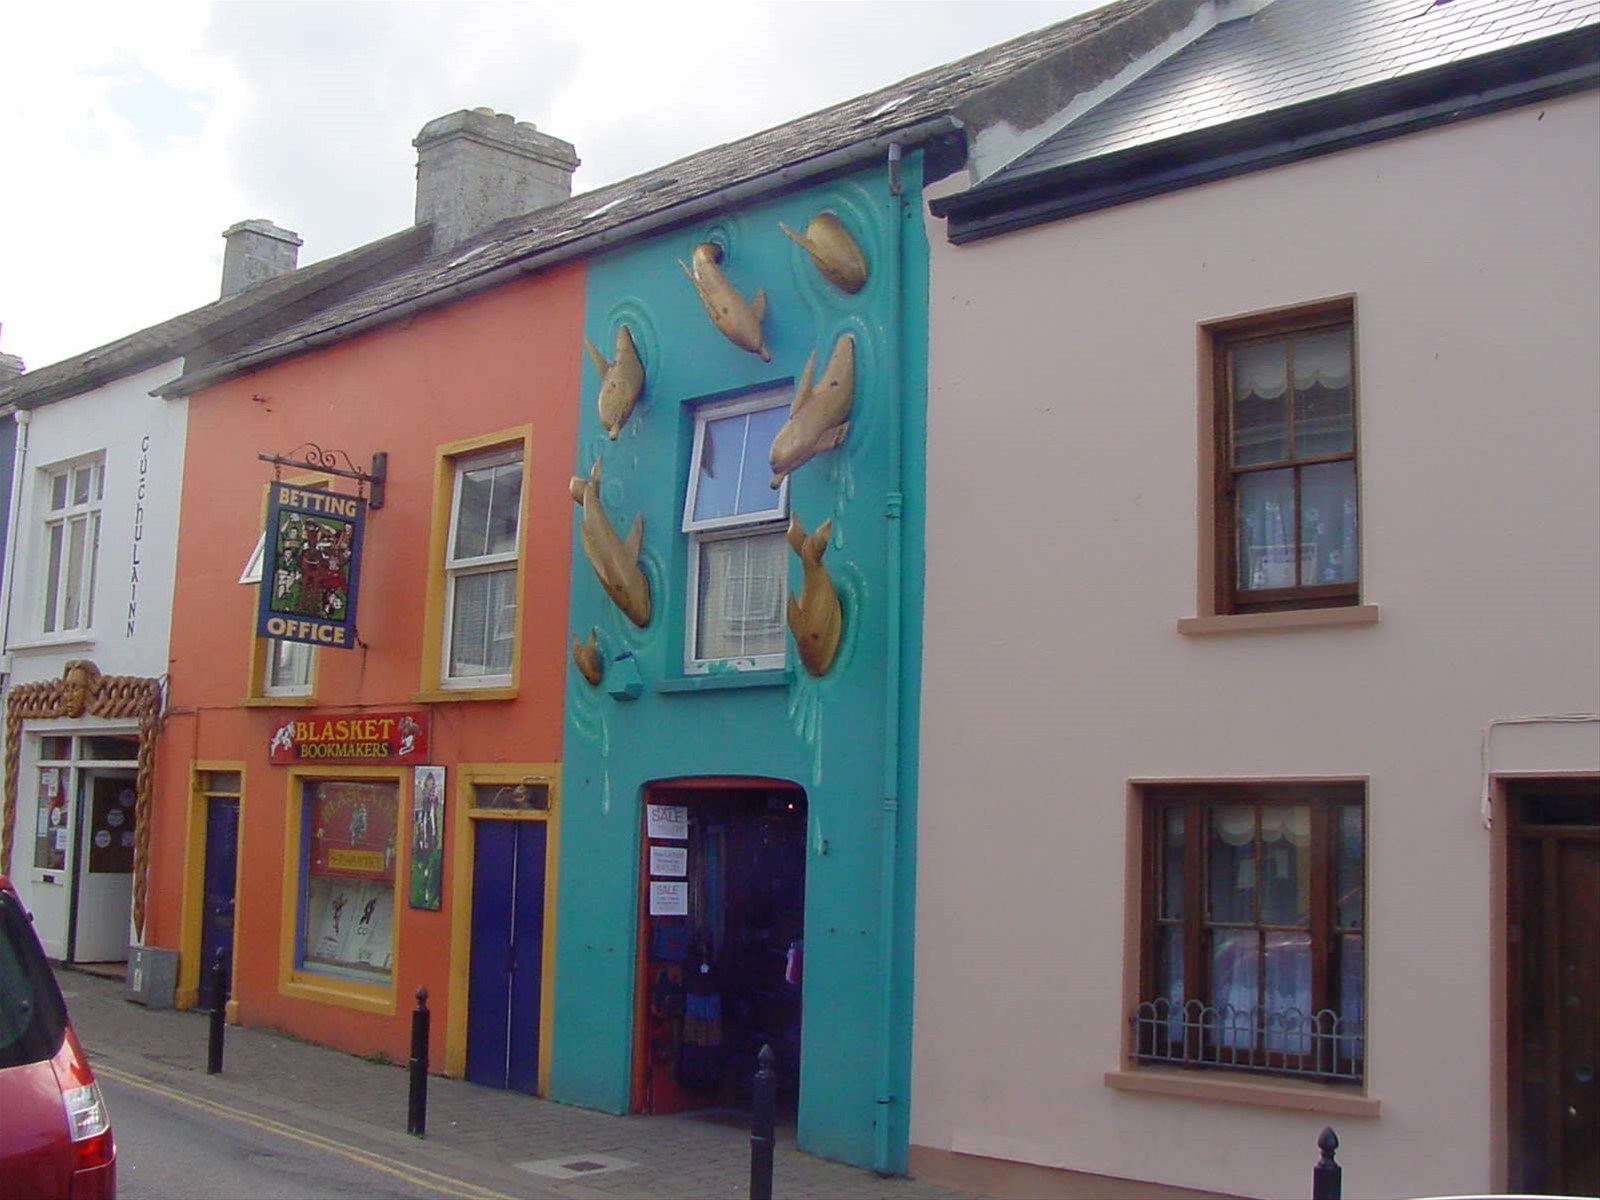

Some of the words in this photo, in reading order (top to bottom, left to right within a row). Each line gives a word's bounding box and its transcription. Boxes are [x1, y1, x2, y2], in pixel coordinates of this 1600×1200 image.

[279, 487, 357, 518] BETTING
[267, 617, 346, 644] OFFICE
[295, 719, 395, 741] BLASKET
[300, 742, 389, 758] BOOKMAKERS
[651, 809, 684, 823] SALE
